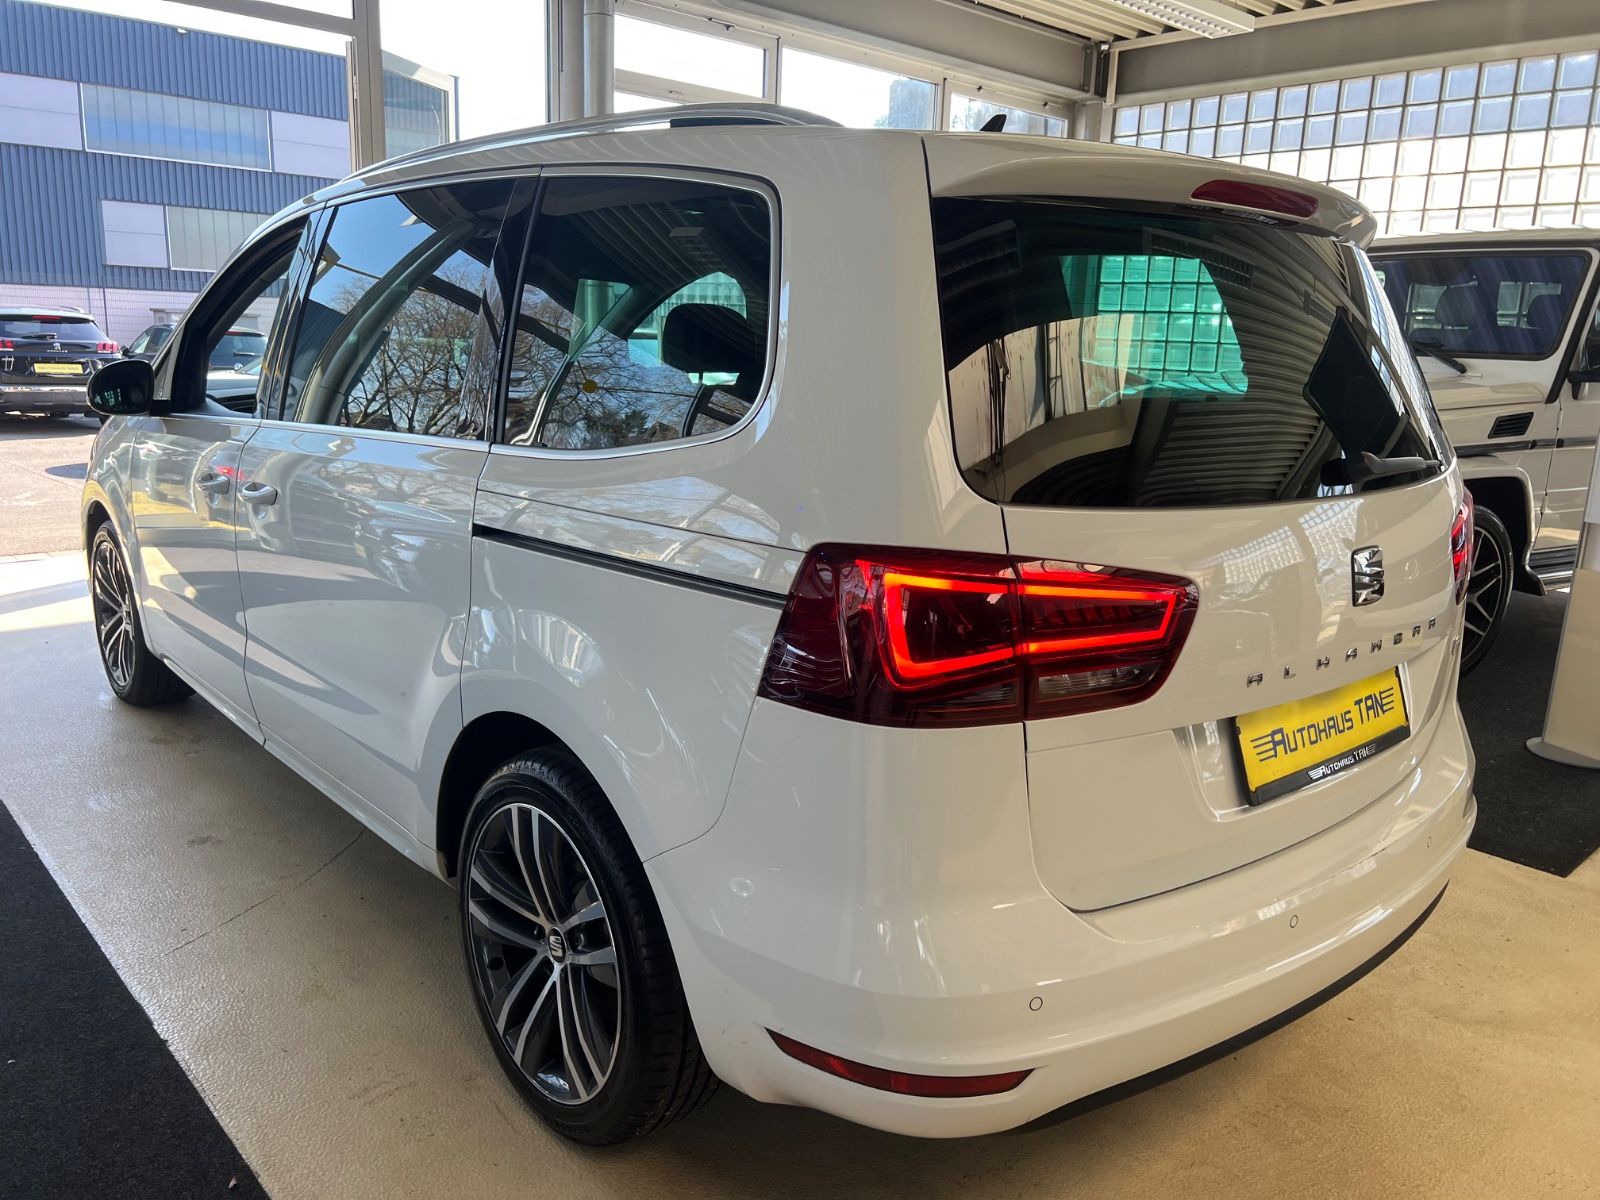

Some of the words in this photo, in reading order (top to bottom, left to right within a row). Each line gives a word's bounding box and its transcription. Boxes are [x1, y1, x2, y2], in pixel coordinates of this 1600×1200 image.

[1246, 617, 1436, 688] ALHAMBRA
[1269, 709, 1354, 758] AUTOHAUS
[1354, 690, 1386, 725] TAN
[1319, 755, 1355, 776] AUTOHAUS
